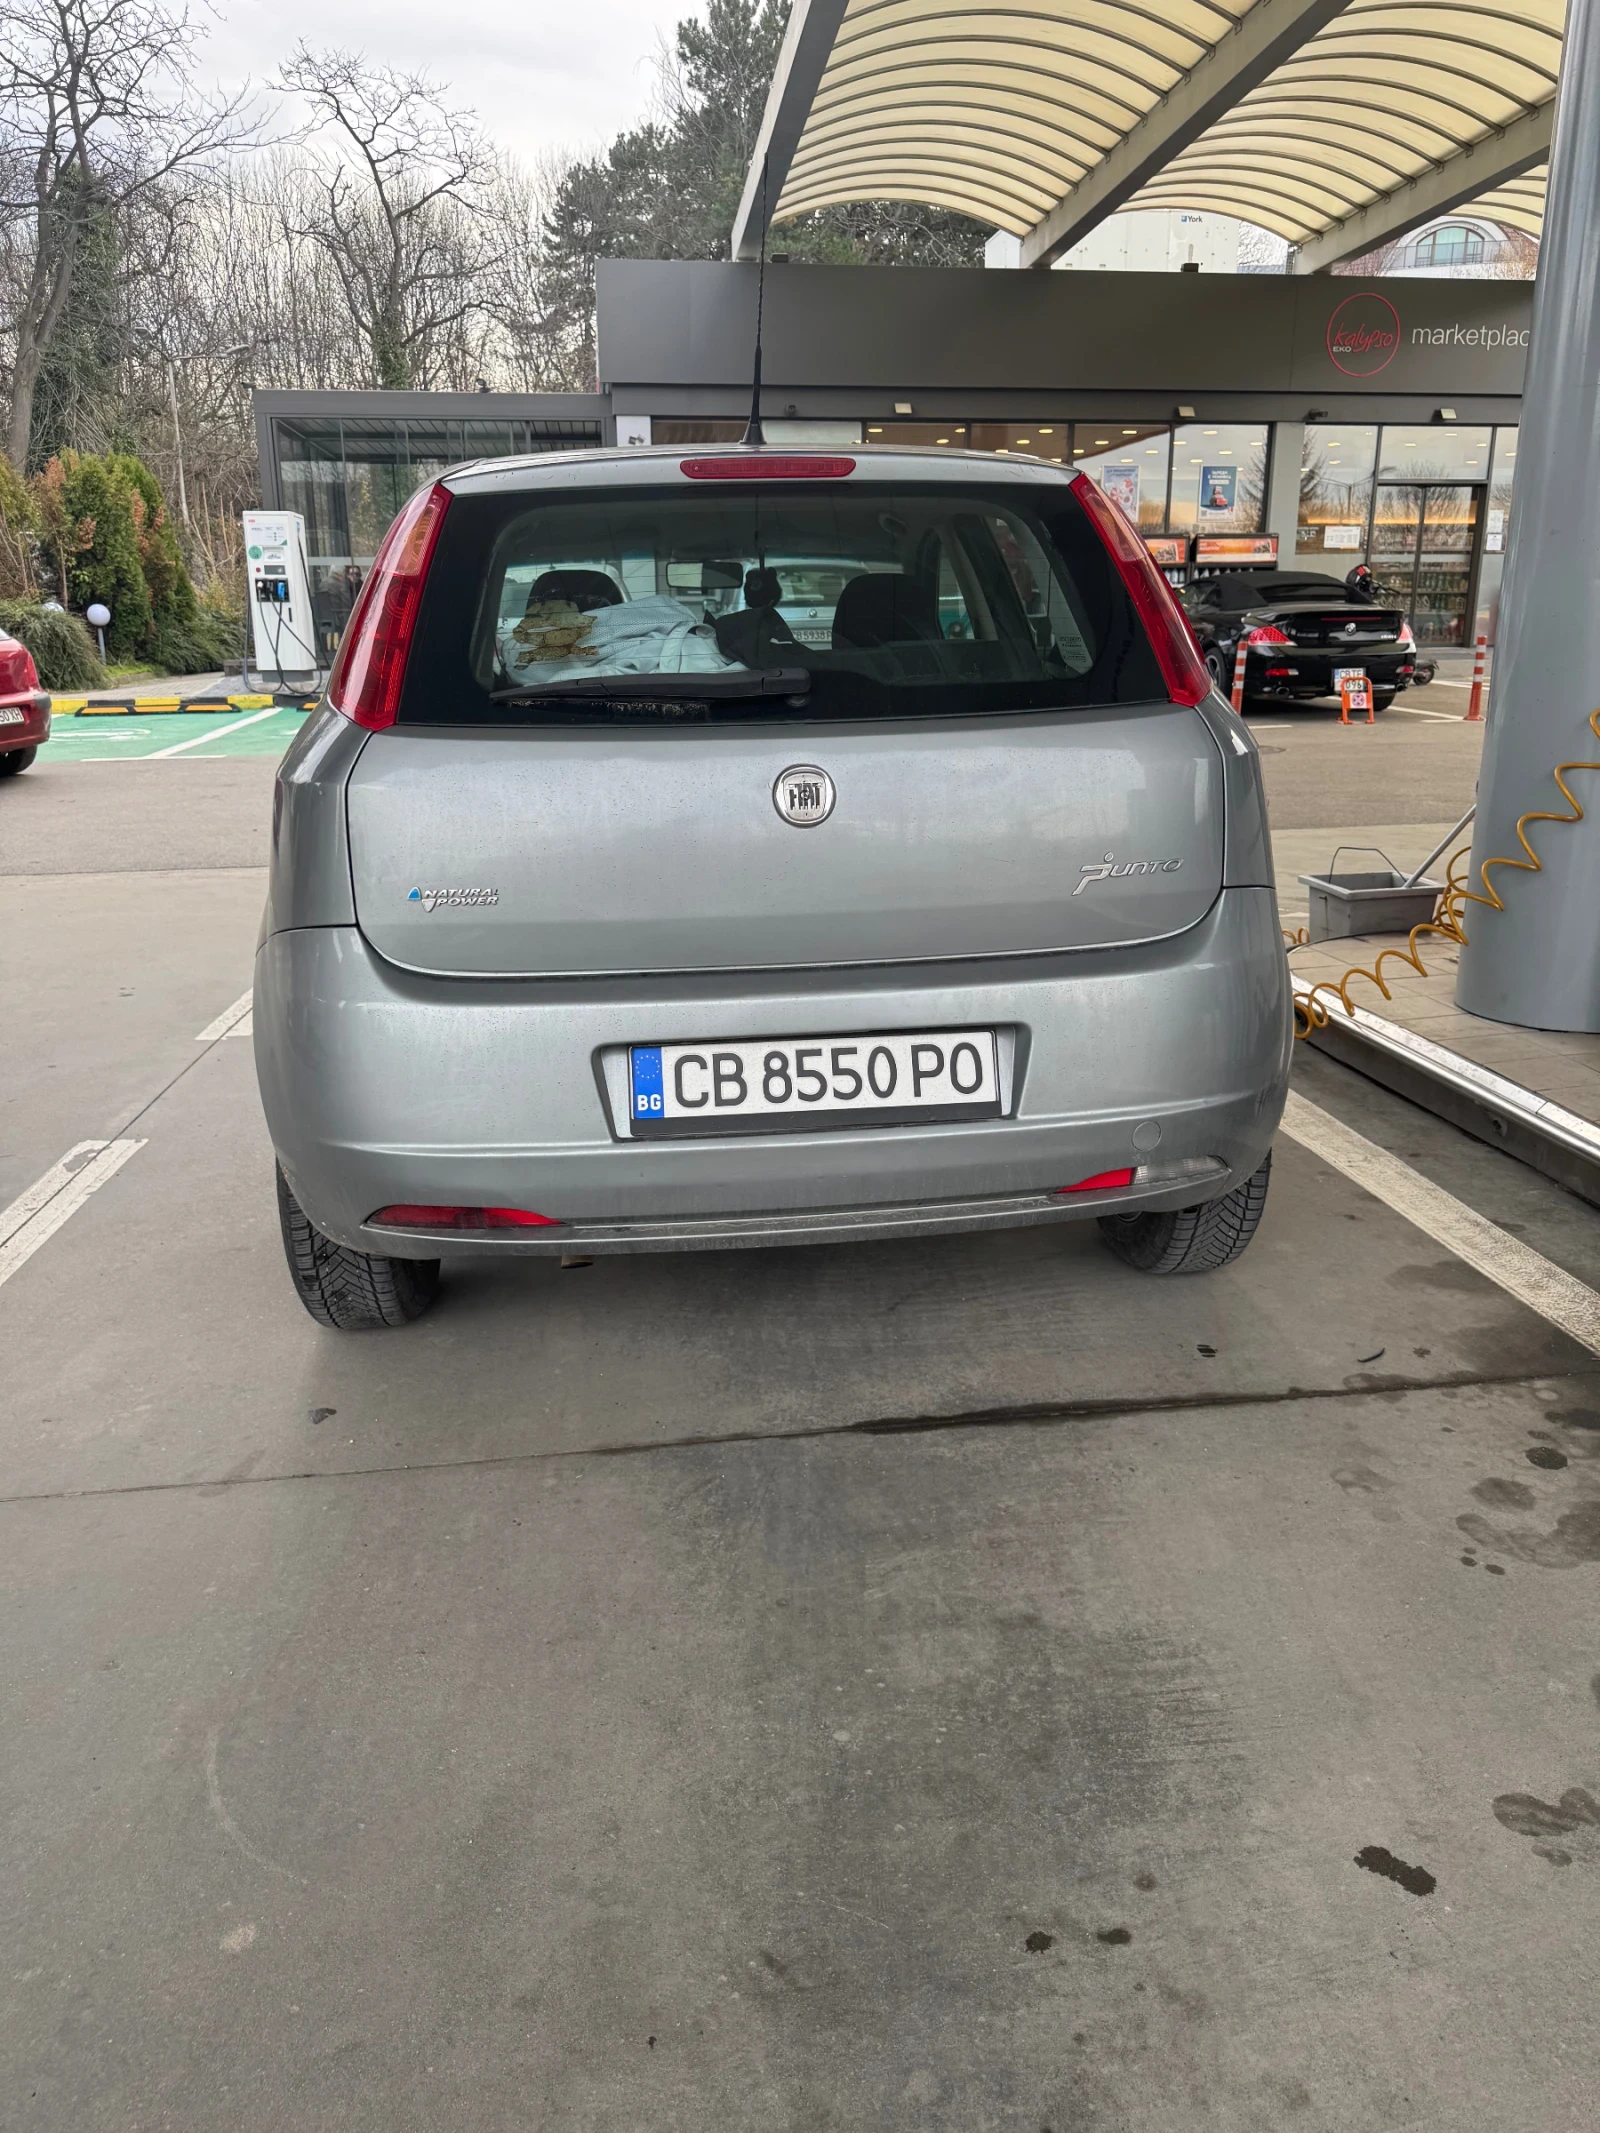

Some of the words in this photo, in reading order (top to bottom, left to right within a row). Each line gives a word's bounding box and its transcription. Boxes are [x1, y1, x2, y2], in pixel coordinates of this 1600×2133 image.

[1411, 323, 1530, 351] marketplac
[787, 782, 823, 810] FIAT
[424, 888, 500, 898] NATURAL
[436, 897, 499, 907] POWER
[674, 1052, 747, 1108] CB
[763, 1046, 897, 1103] 8550
[911, 1042, 983, 1097] PO
[637, 1095, 661, 1111] BG
